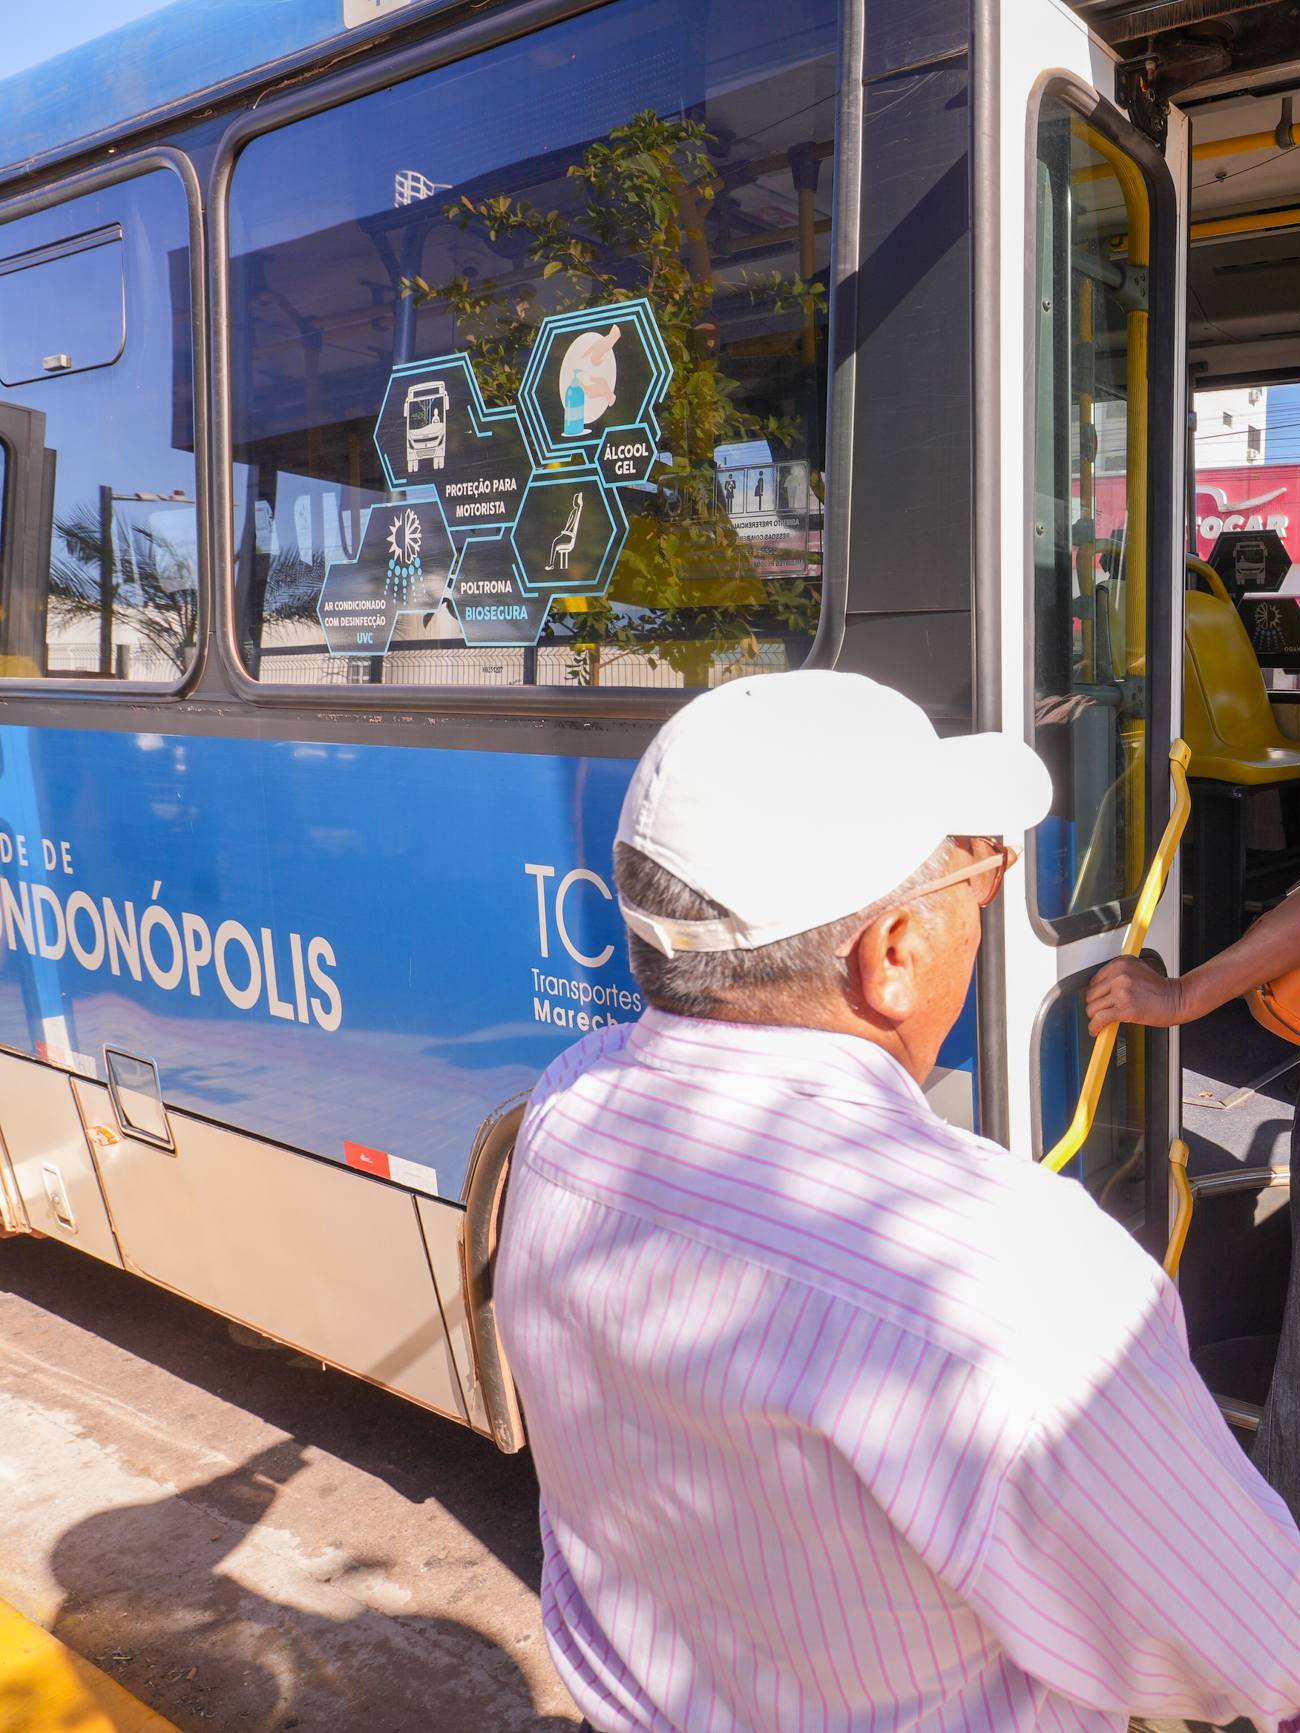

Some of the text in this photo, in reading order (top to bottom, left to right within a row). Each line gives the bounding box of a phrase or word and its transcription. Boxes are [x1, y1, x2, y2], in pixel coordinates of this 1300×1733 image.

[604, 443, 649, 460] ÁLCOOL
[615, 460, 636, 475] GEL
[445, 477, 517, 498] PROTEÇÃO PARA
[456, 501, 505, 518] MOTORISTA
[1196, 514, 1289, 540] OCAR
[460, 580, 513, 595] POLTRONA
[324, 600, 386, 611] AR CONDICIONADO
[465, 605, 528, 621] BIOSEGURA
[324, 614, 386, 628] COM DESINFECÇÃO
[356, 632, 374, 644] UVC
[42, 838, 74, 874] DE
[525, 863, 633, 973] TC
[0, 877, 343, 1032] NDONÓPOLIS
[531, 968, 642, 1012] Transportes
[533, 997, 634, 1032] Marech
